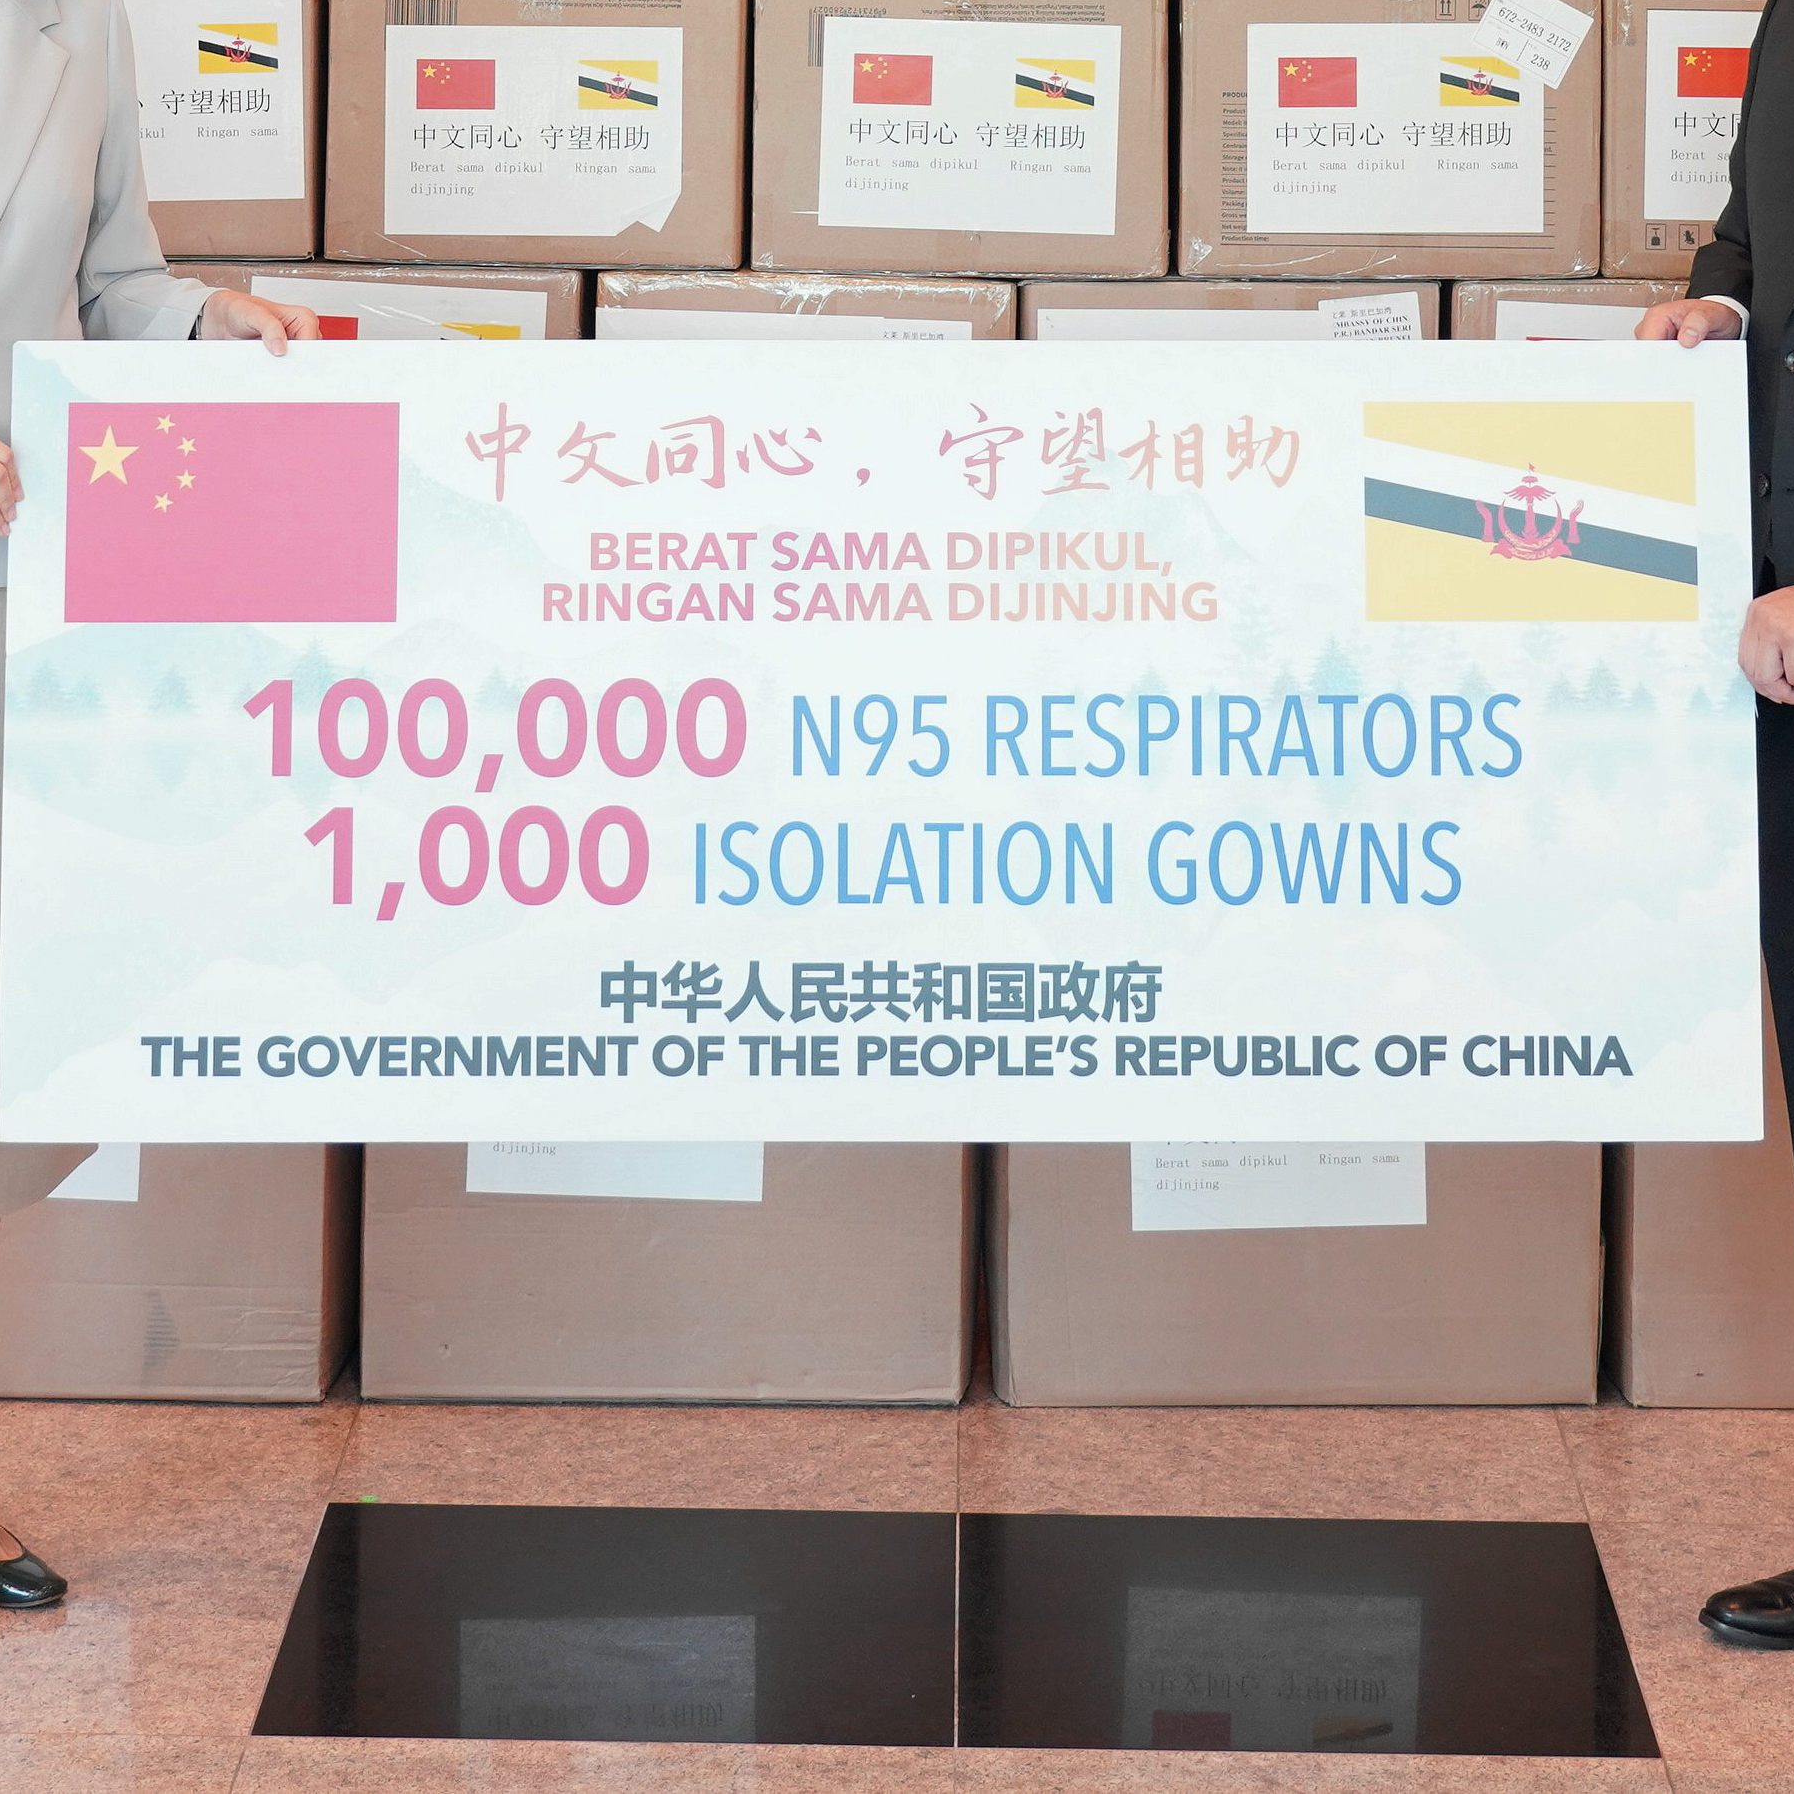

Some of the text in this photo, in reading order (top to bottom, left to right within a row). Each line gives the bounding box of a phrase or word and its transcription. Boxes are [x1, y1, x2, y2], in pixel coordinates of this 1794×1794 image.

[1498, 7, 1571, 52] 672-2483 2172
[1530, 53, 1551, 70] 238
[161, 87, 271, 115] 守望相助
[140, 127, 278, 139] ikul Ringan sama
[414, 124, 649, 150] 中文同心 守望相助
[850, 118, 1085, 149] 中文同心 守望相助
[1276, 121, 1511, 147] 中文同心 守望相助
[1671, 149, 1706, 160] Berat
[410, 160, 657, 177] Berat sama dipikul Ringan sama
[844, 154, 1092, 175] Berat sama dipikul Ringan sama
[1272, 158, 1519, 173] Berat sama dipikul Ringan sama
[844, 176, 910, 192] dijinjing
[1670, 171, 1731, 184] dijinjin
[410, 182, 475, 197] dijinjing
[1272, 180, 1338, 195] dijinjing
[591, 531, 1172, 576] BERAT SAMA DIPIKUL,
[543, 582, 1217, 622] RINGAN SAMA DIJINJING
[242, 675, 1522, 793] 100,000 N95 RESPIRATORS
[303, 805, 1461, 921] 1,000 ISOLATION GOWNS
[600, 960, 1163, 1024] 中华人民共和国政府
[140, 1034, 1634, 1078] THE GOVERNMENT OF THE PEOPLE’S REPUBLIC OF CHINA
[492, 1141, 557, 1157] dijinjing
[1156, 1153, 1400, 1169] Berat sama dipikul Ringan sama
[1156, 1178, 1220, 1191] dijinjing
